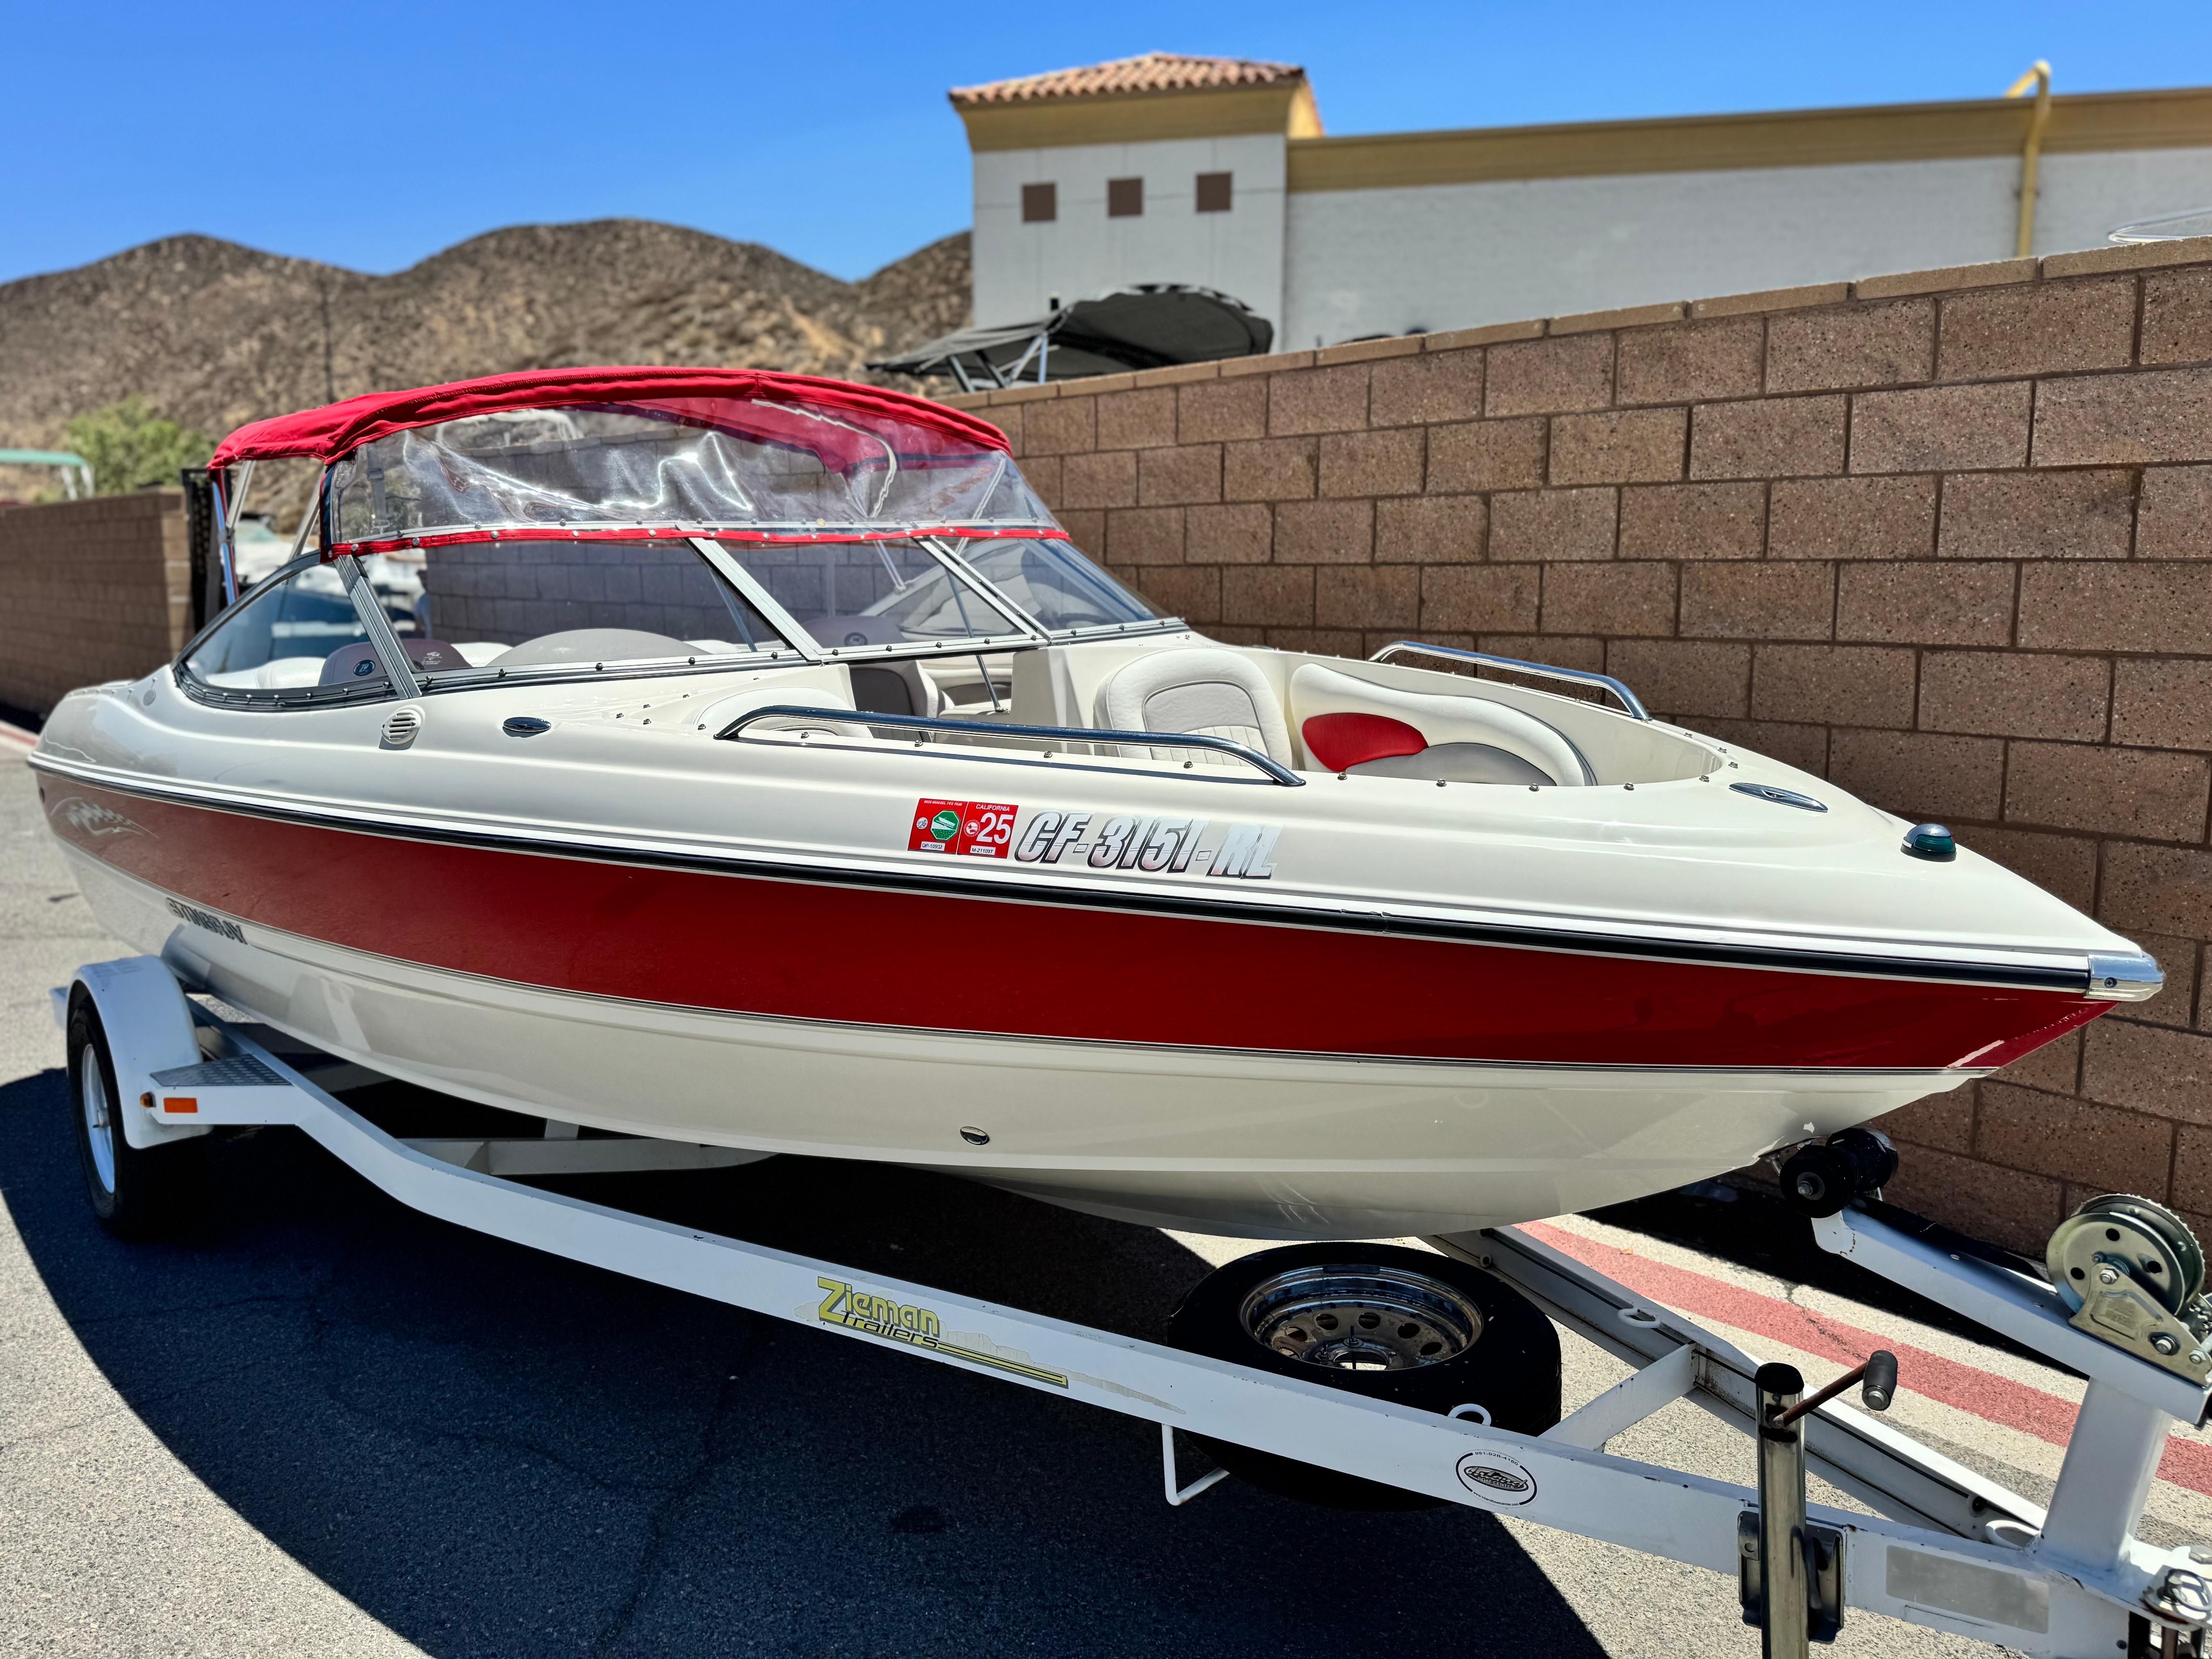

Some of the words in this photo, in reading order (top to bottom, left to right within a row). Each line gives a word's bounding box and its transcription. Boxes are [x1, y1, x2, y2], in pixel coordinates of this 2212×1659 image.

[976, 812, 1014, 844] 25
[818, 1276, 940, 1338] Zieman
[841, 1310, 939, 1348] Trailers
[1493, 1480, 1514, 1489] CENTER
